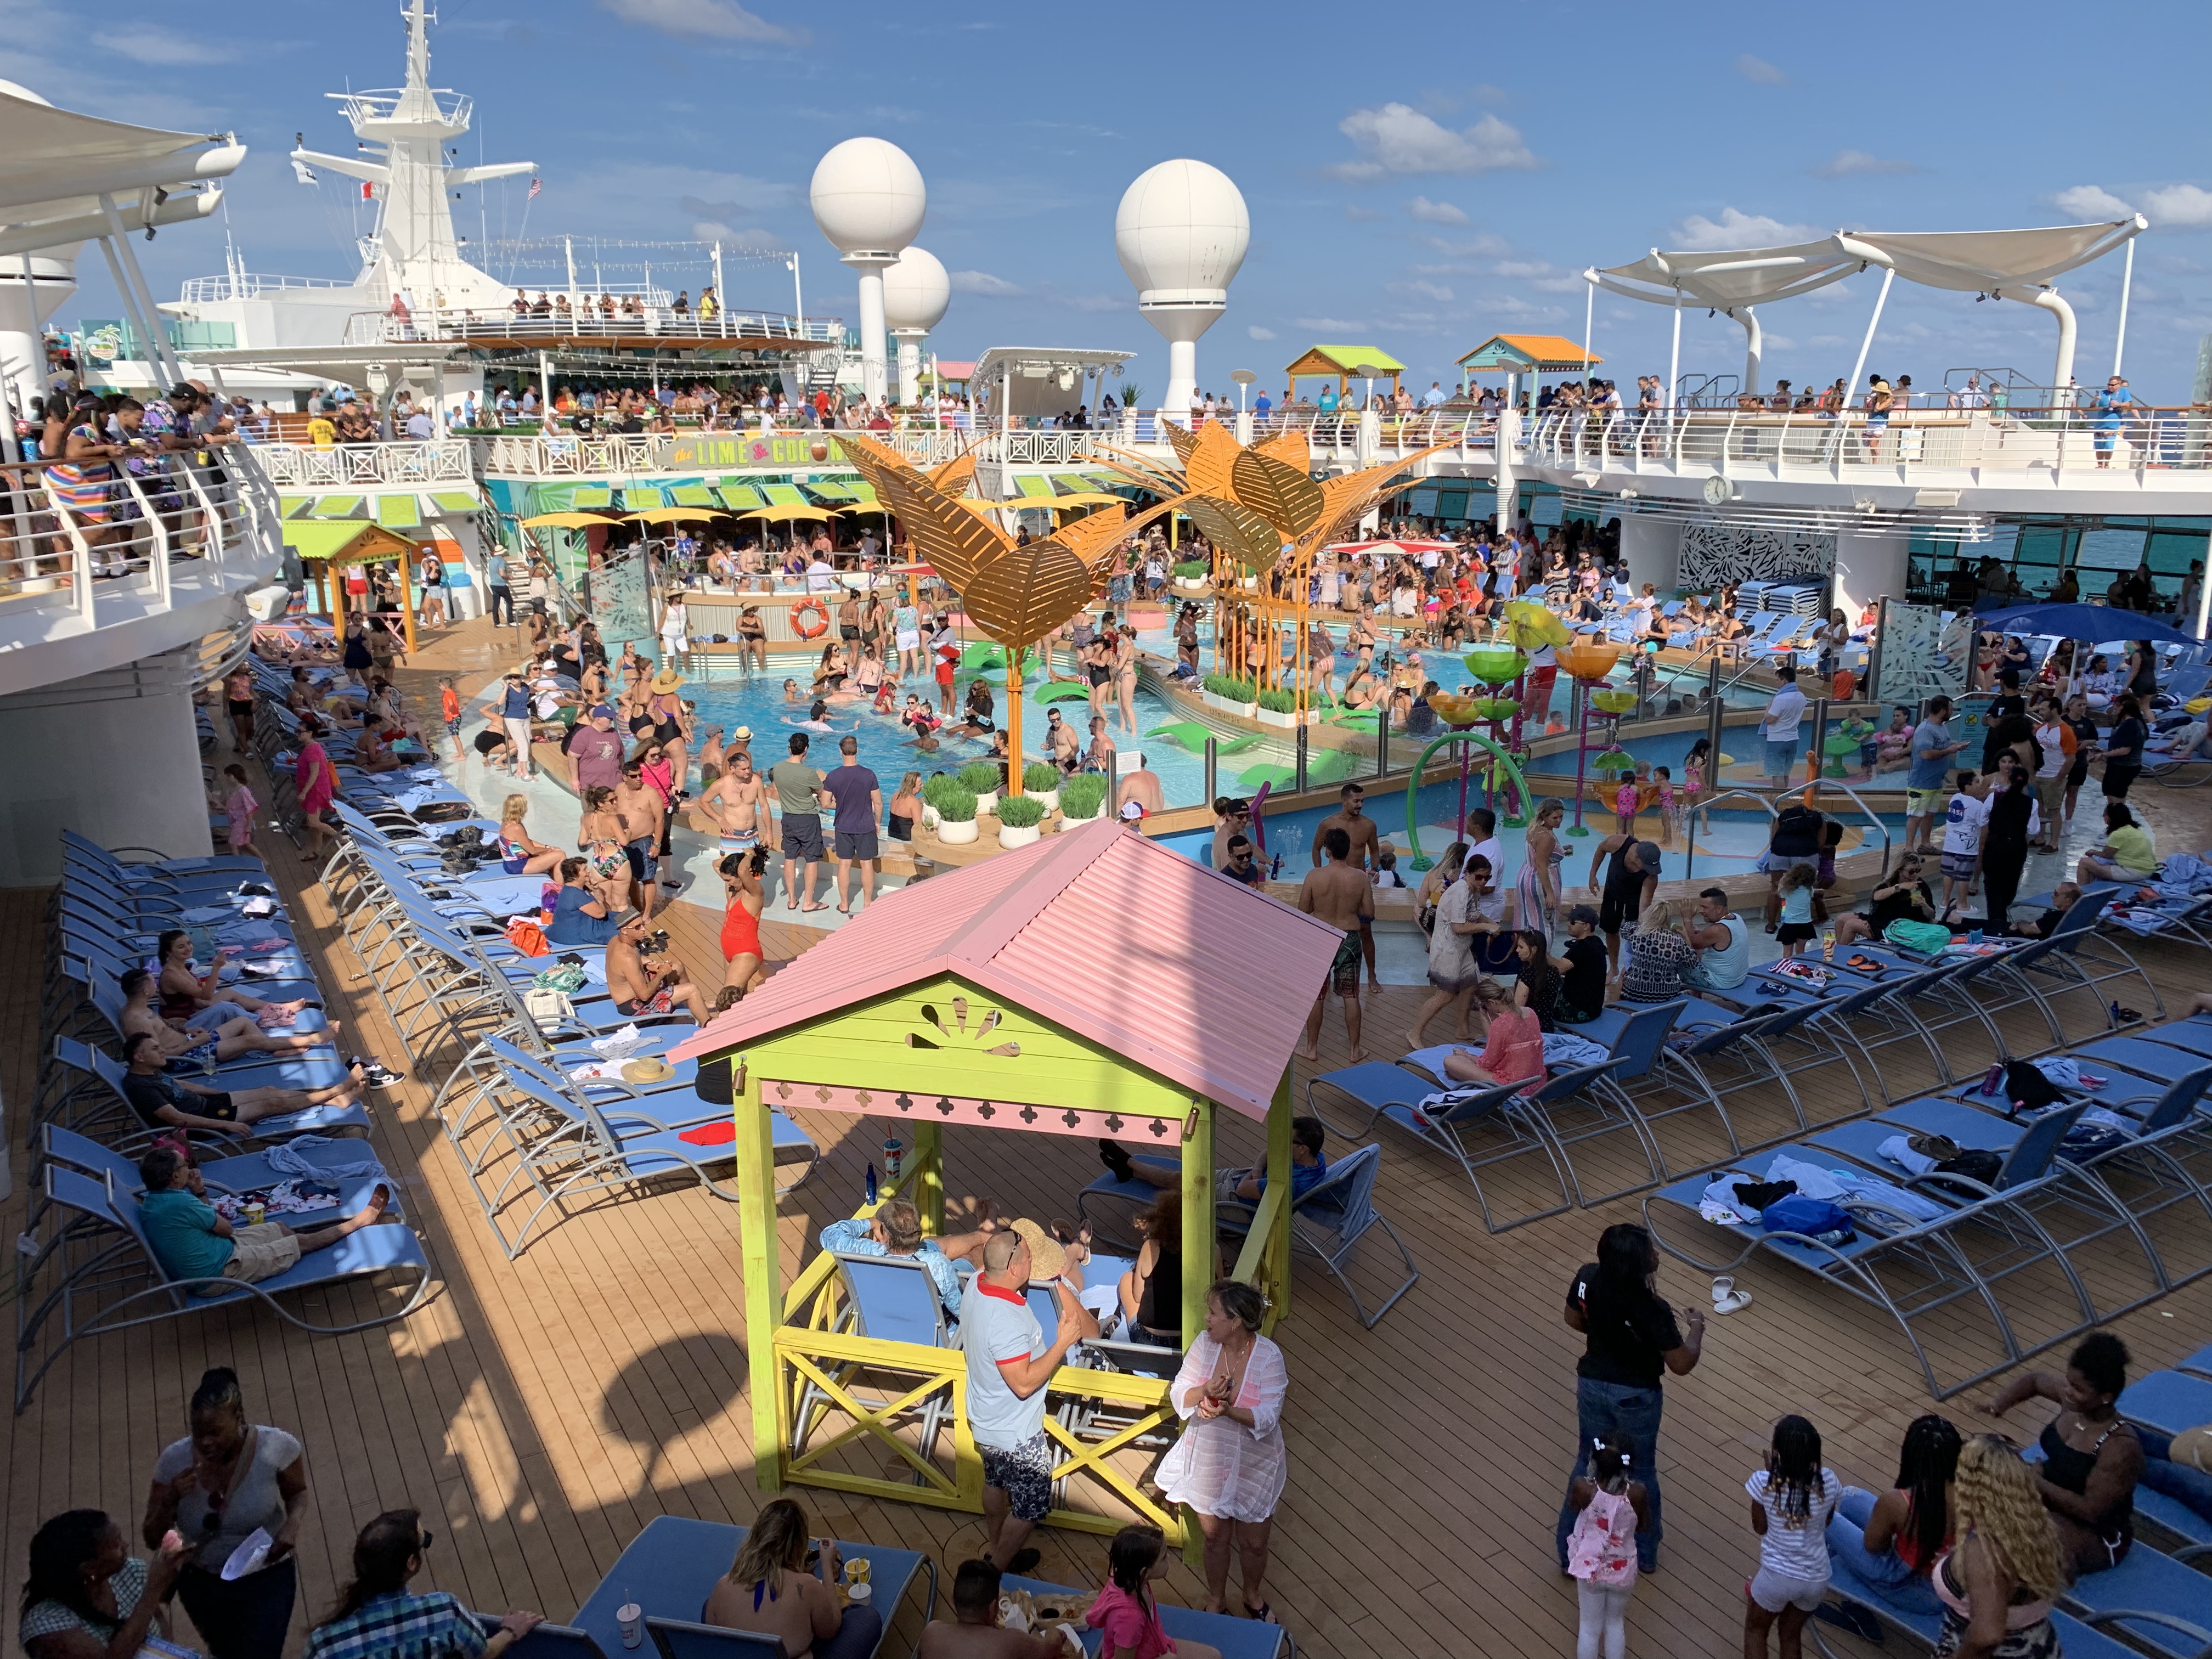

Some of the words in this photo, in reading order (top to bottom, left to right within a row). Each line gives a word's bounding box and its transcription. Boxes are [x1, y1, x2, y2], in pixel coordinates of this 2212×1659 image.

[673, 448, 693, 464] the
[696, 441, 748, 465] LIME
[753, 443, 769, 460] &
